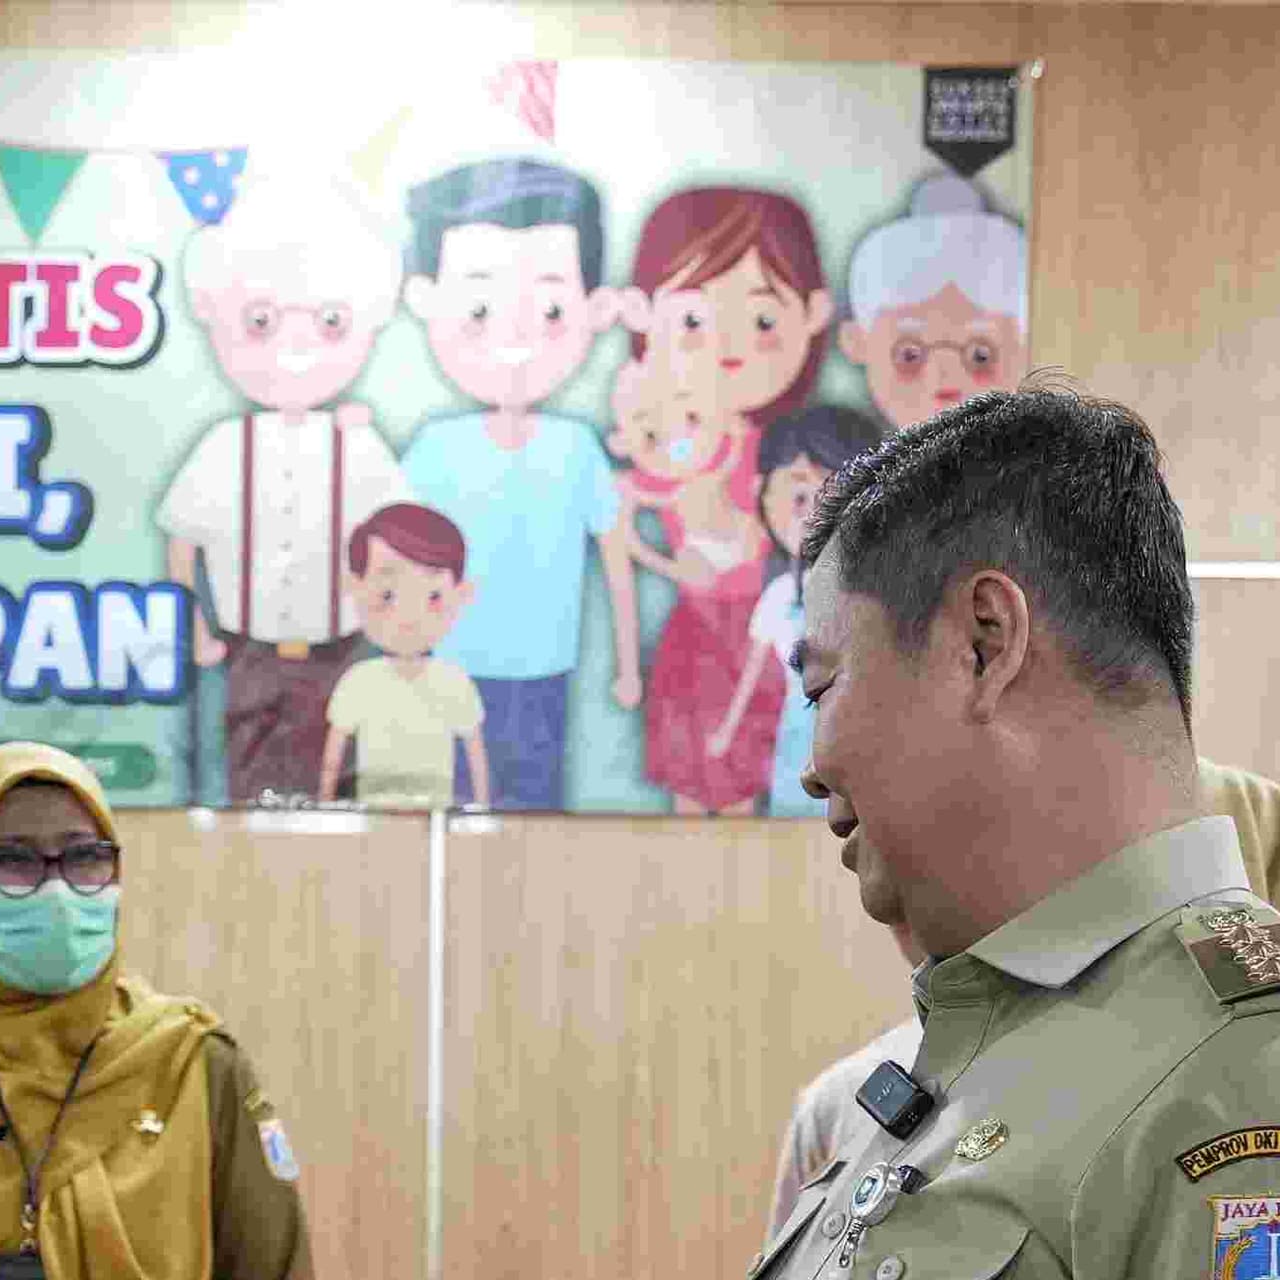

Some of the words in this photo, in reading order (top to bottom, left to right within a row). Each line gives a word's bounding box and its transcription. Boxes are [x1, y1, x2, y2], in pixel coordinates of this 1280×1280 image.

[1183, 1136, 1249, 1173] PEMPROV
[1254, 1131, 1279, 1149] DKI
[1221, 1202, 1269, 1221] JAYA
